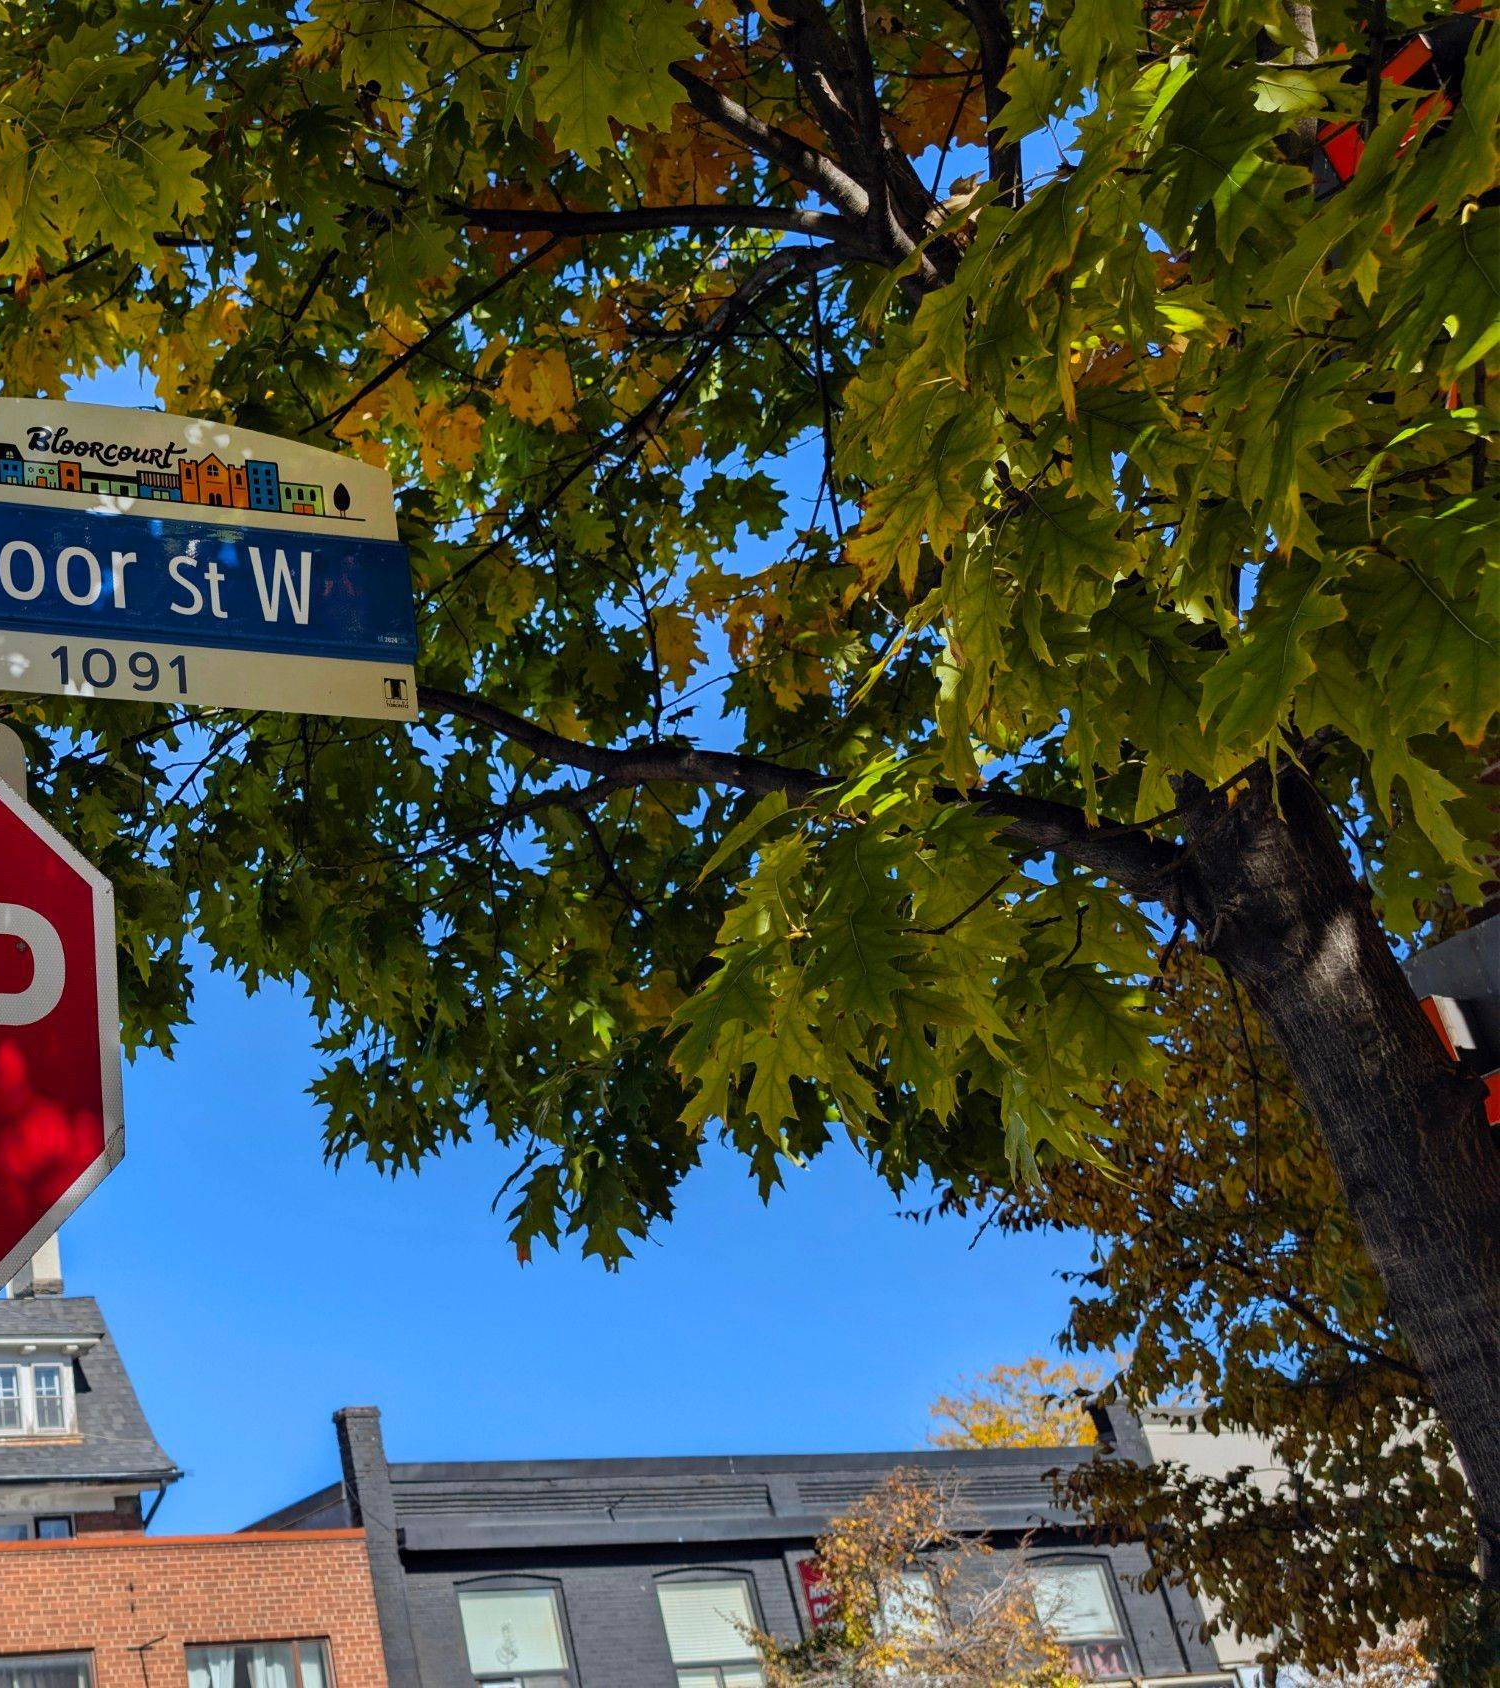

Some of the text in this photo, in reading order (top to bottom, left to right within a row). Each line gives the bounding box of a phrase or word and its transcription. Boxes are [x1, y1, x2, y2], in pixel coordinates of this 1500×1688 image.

[26, 426, 188, 470] Bloorcourt
[170, 553, 228, 619] St
[248, 546, 312, 625] W
[51, 645, 189, 694] 1091
